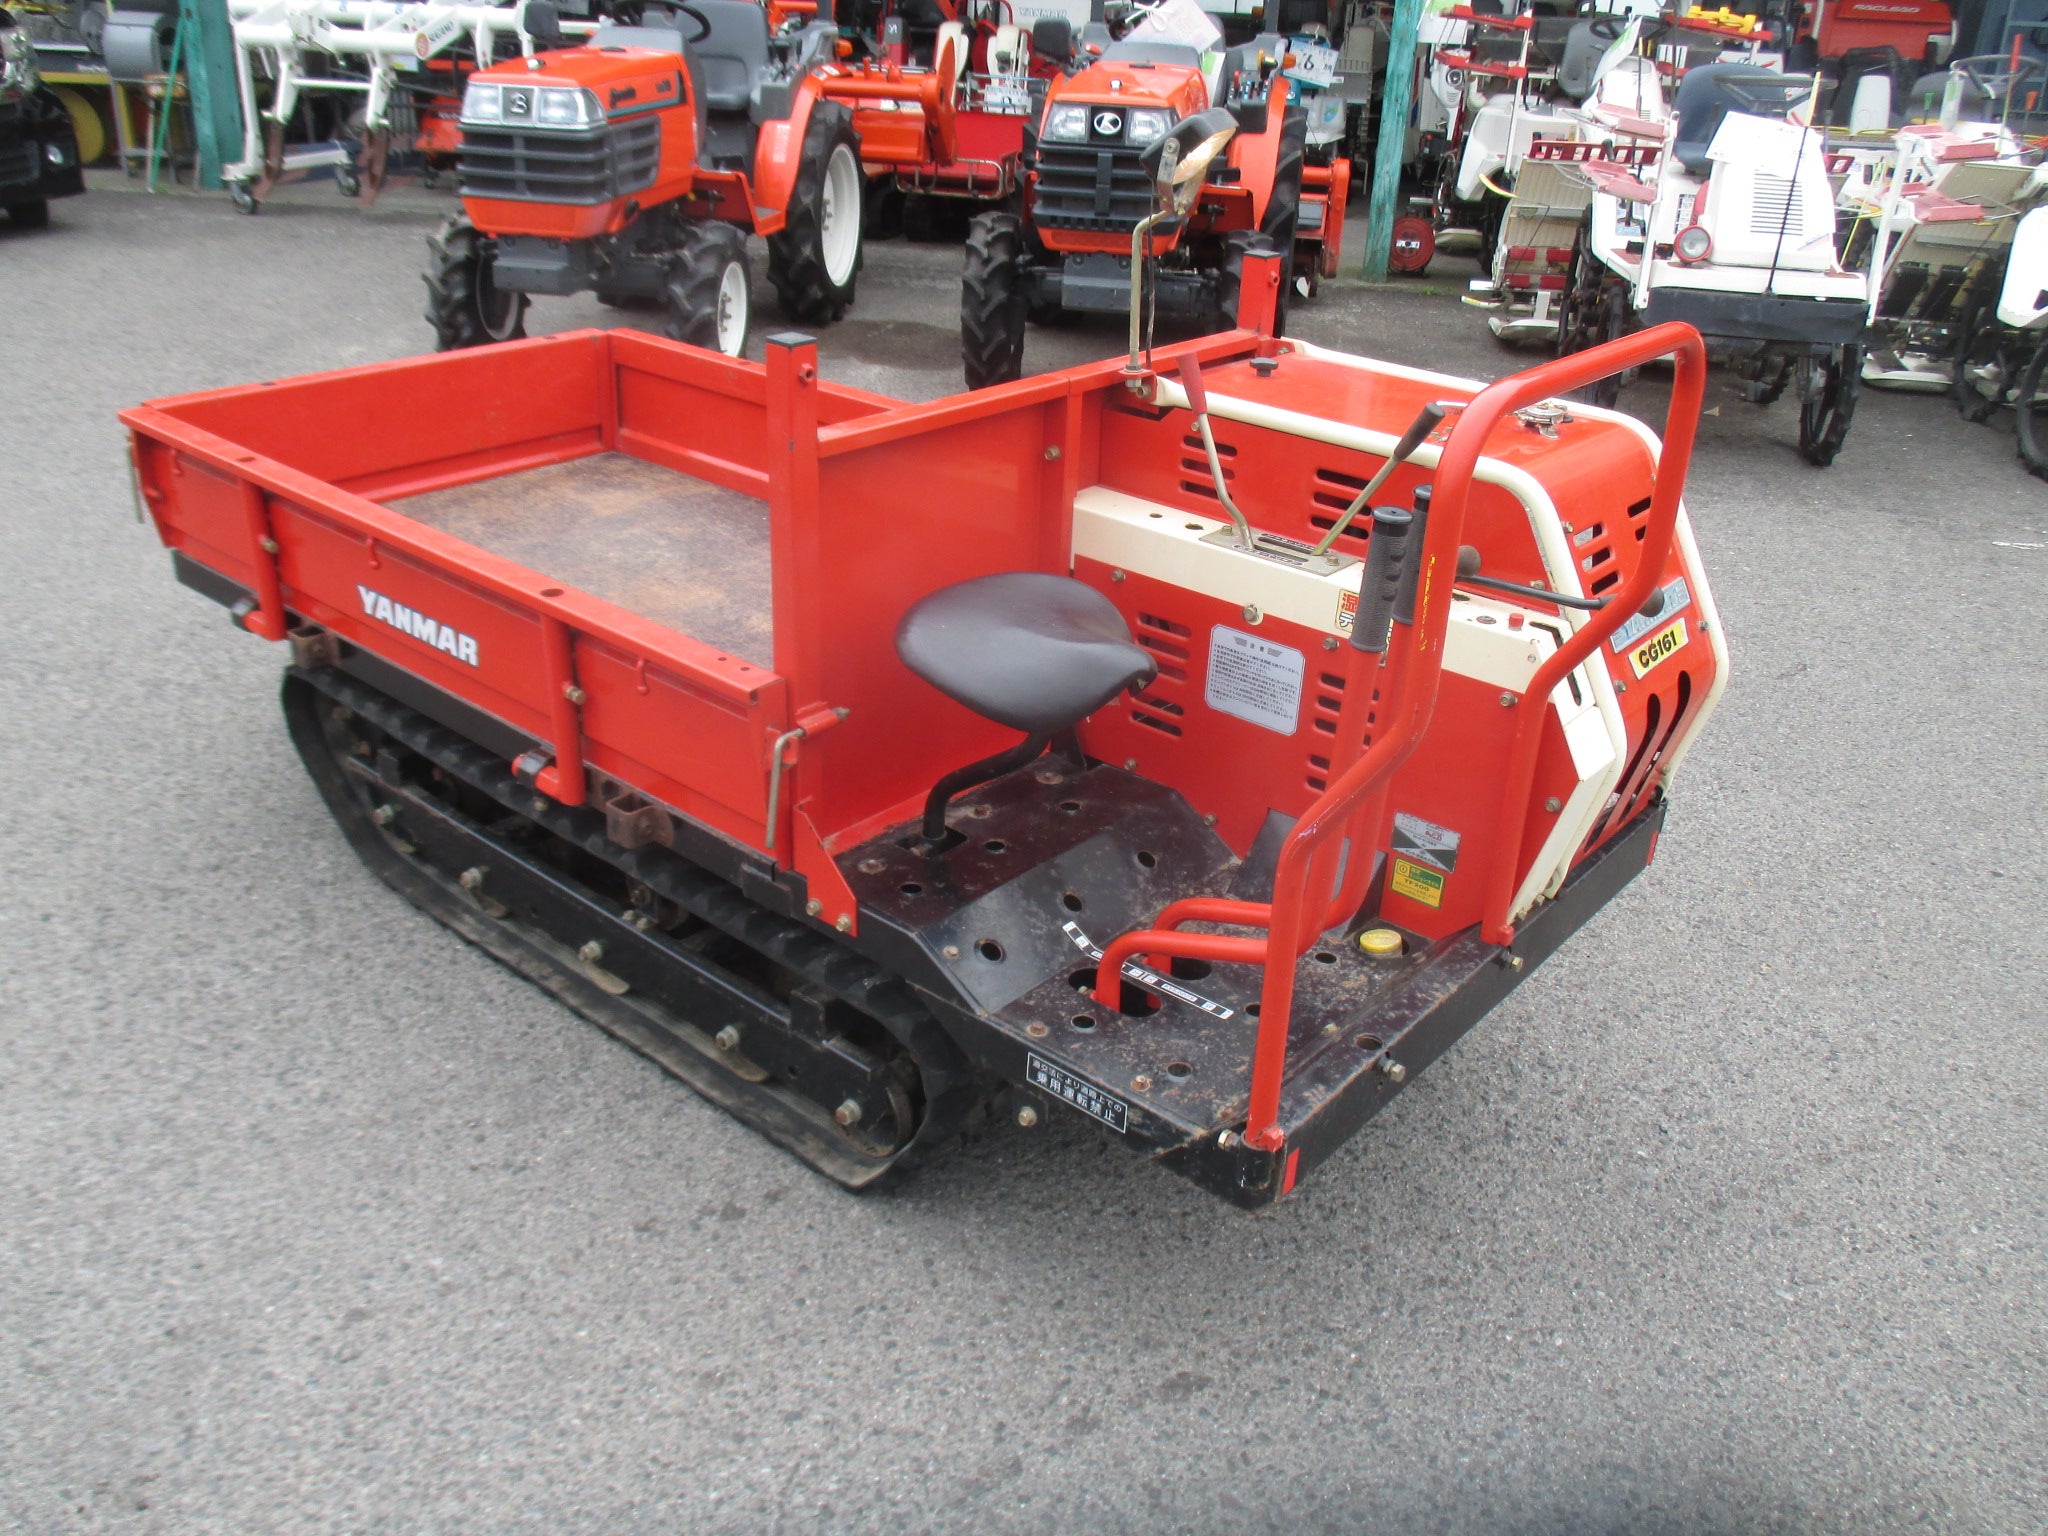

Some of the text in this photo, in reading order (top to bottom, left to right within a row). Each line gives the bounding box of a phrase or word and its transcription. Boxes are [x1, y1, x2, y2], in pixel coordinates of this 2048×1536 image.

[356, 583, 480, 667] YANMAR
[1638, 630, 1677, 668] CG161
[1036, 1071, 1116, 1124] 乗用運転禁止
